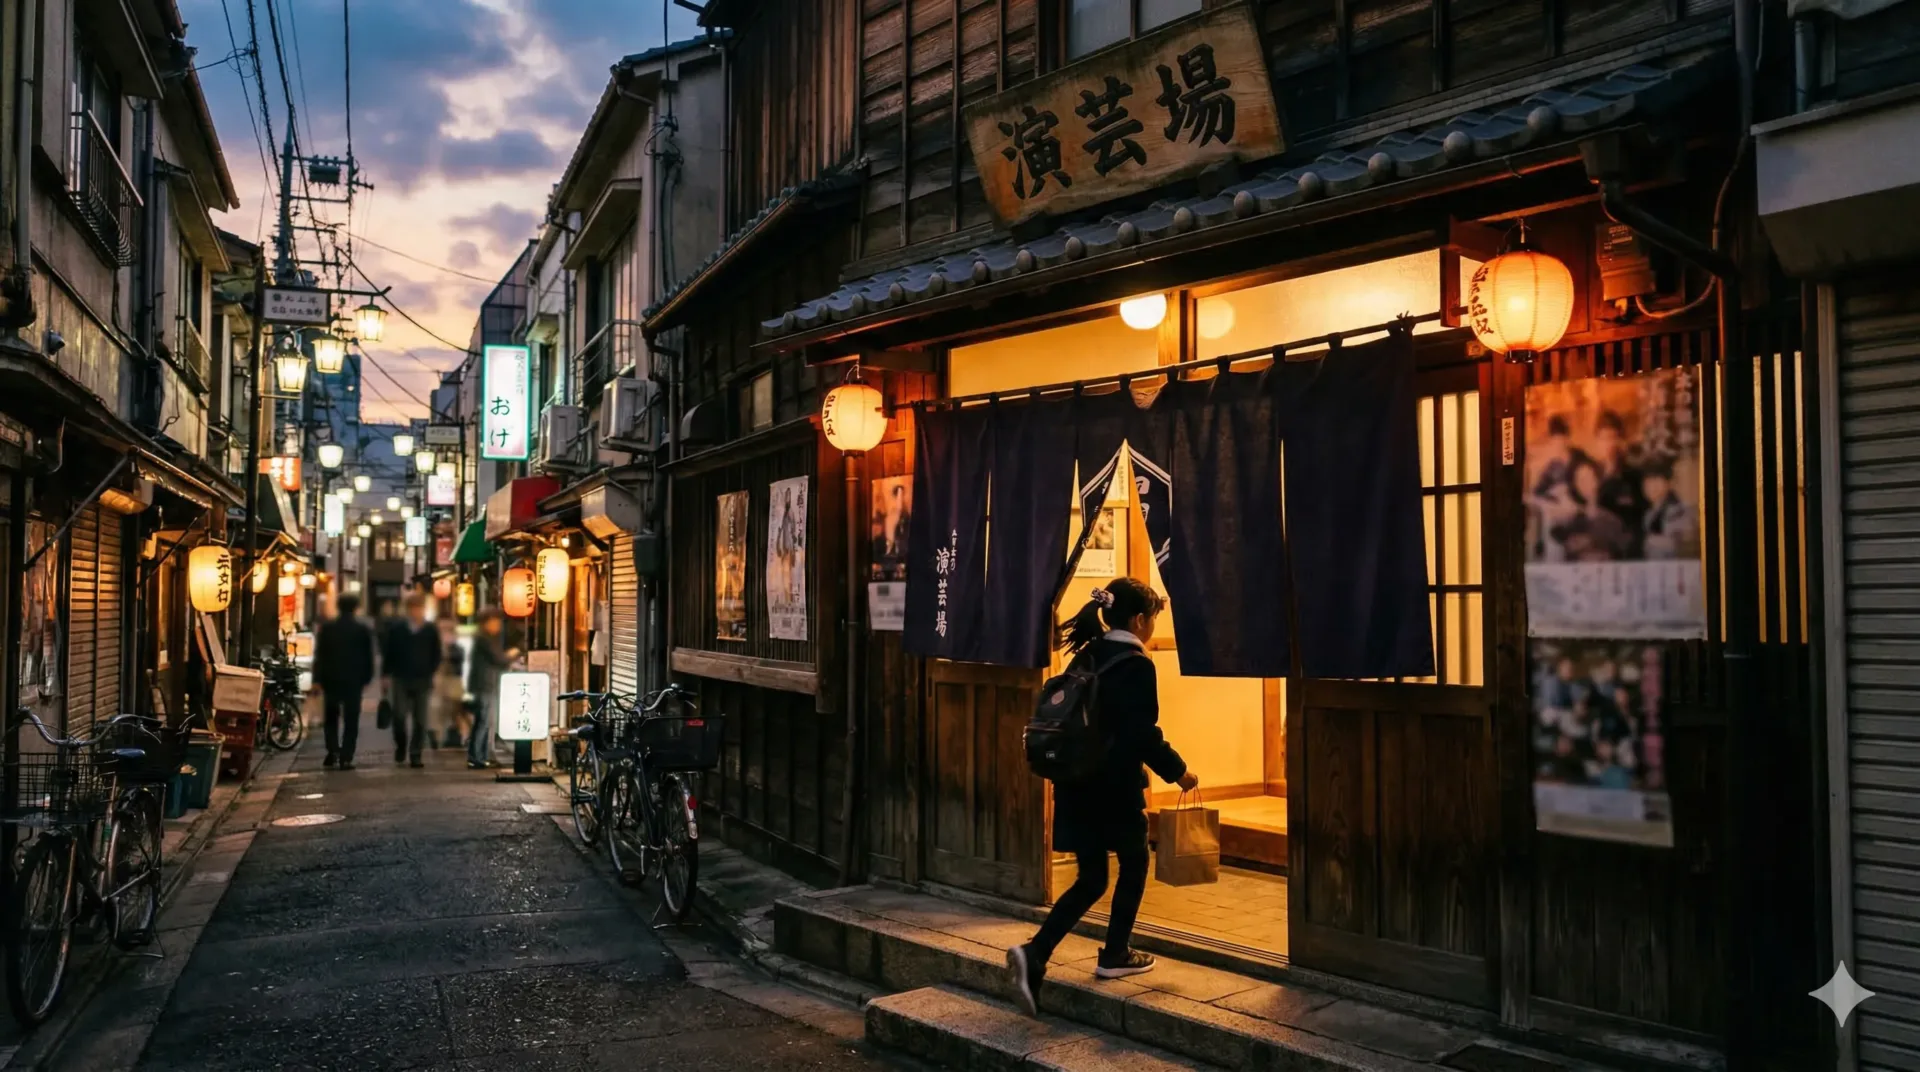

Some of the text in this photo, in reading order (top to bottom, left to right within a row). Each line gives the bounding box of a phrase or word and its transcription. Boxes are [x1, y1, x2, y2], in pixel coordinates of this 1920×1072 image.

[998, 43, 1236, 200] 演芸場
[490, 396, 510, 448] おけ
